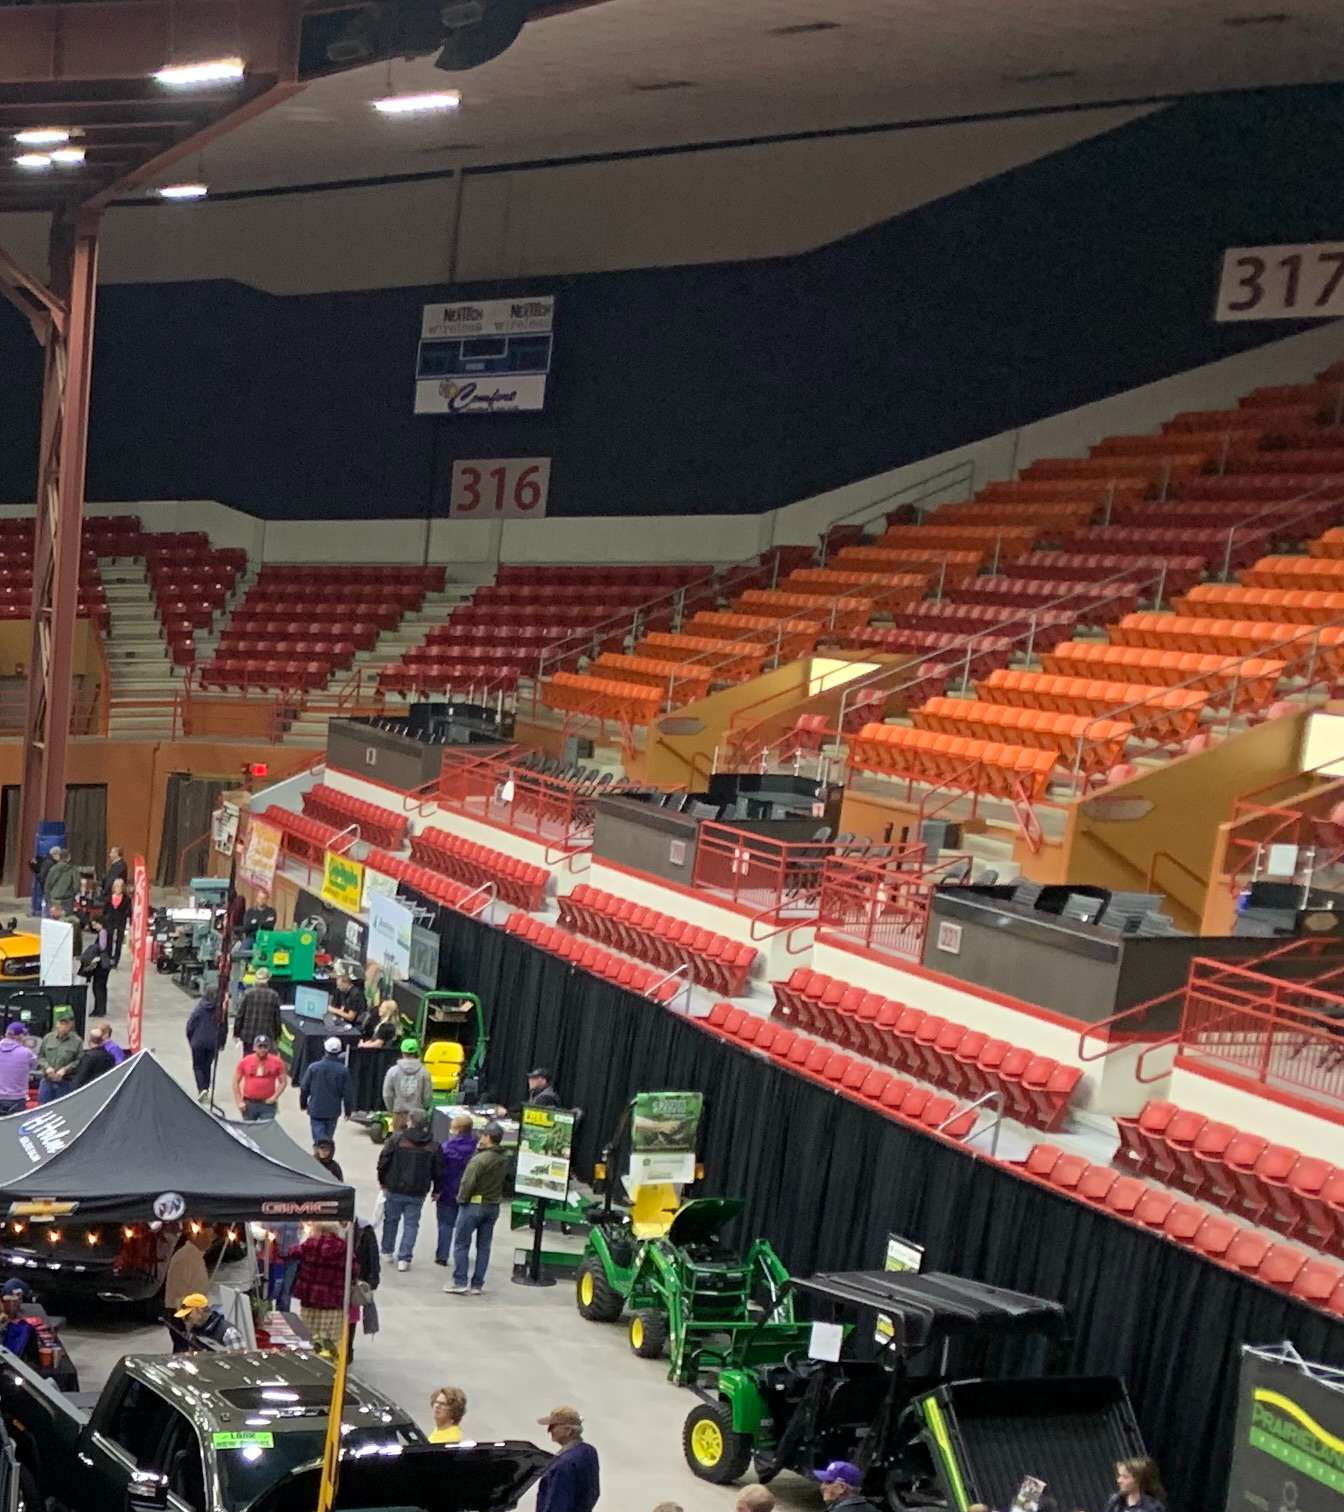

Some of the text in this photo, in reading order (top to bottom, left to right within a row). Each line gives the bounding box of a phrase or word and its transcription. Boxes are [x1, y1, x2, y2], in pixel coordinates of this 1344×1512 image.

[1229, 252, 1344, 312] 317
[455, 465, 542, 512] 316
[260, 1201, 339, 1214] GMC
